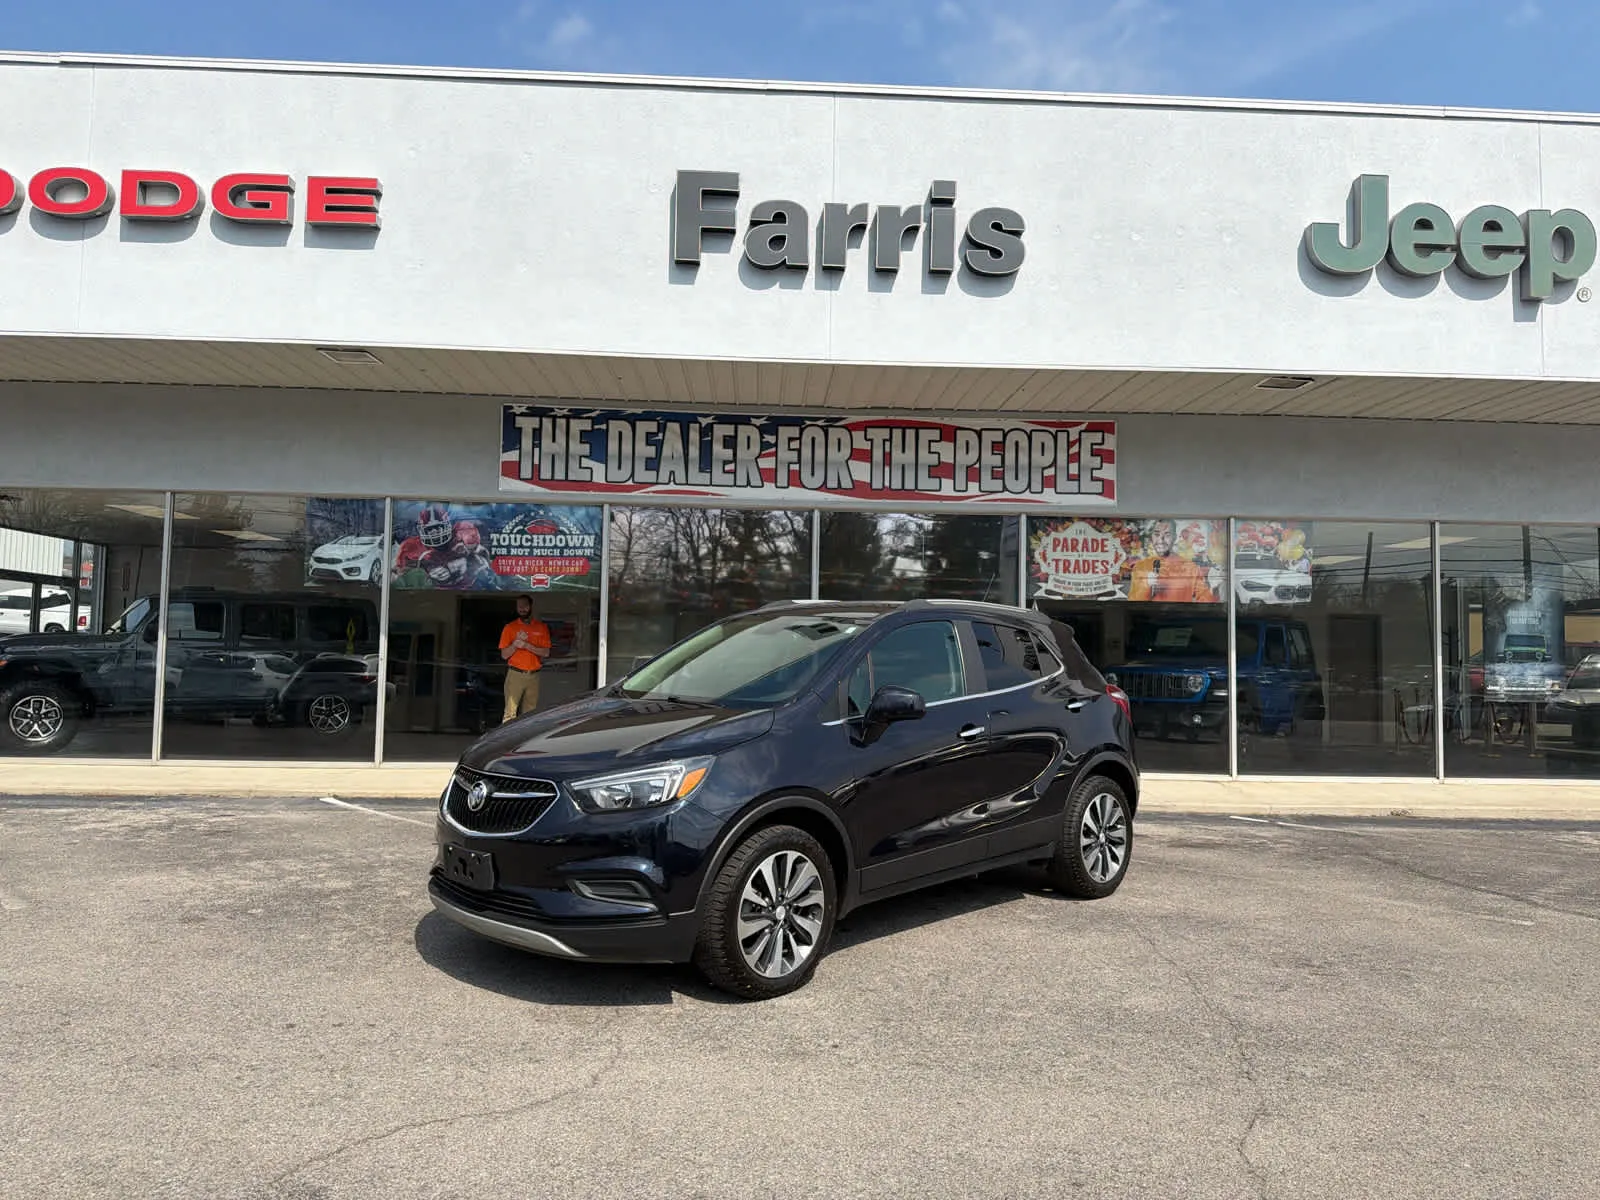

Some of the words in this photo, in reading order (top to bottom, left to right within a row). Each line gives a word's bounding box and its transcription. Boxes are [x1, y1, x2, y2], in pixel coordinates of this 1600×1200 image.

[0, 166, 383, 231] ODGE
[673, 169, 1025, 277] Farris
[1304, 174, 1597, 302] Jeep
[514, 414, 593, 482] THE
[605, 418, 764, 488] DEALER
[775, 424, 854, 490] FOR
[864, 426, 942, 493] THE
[953, 428, 1105, 494] PEOPLE
[490, 533, 595, 547] TOUCHDOWN
[491, 547, 508, 555] FOR
[510, 548, 530, 556] NOT
[563, 549, 594, 557] DOWN!
[1052, 537, 1109, 552] PARADE
[1052, 558, 1109, 574] TRADES
